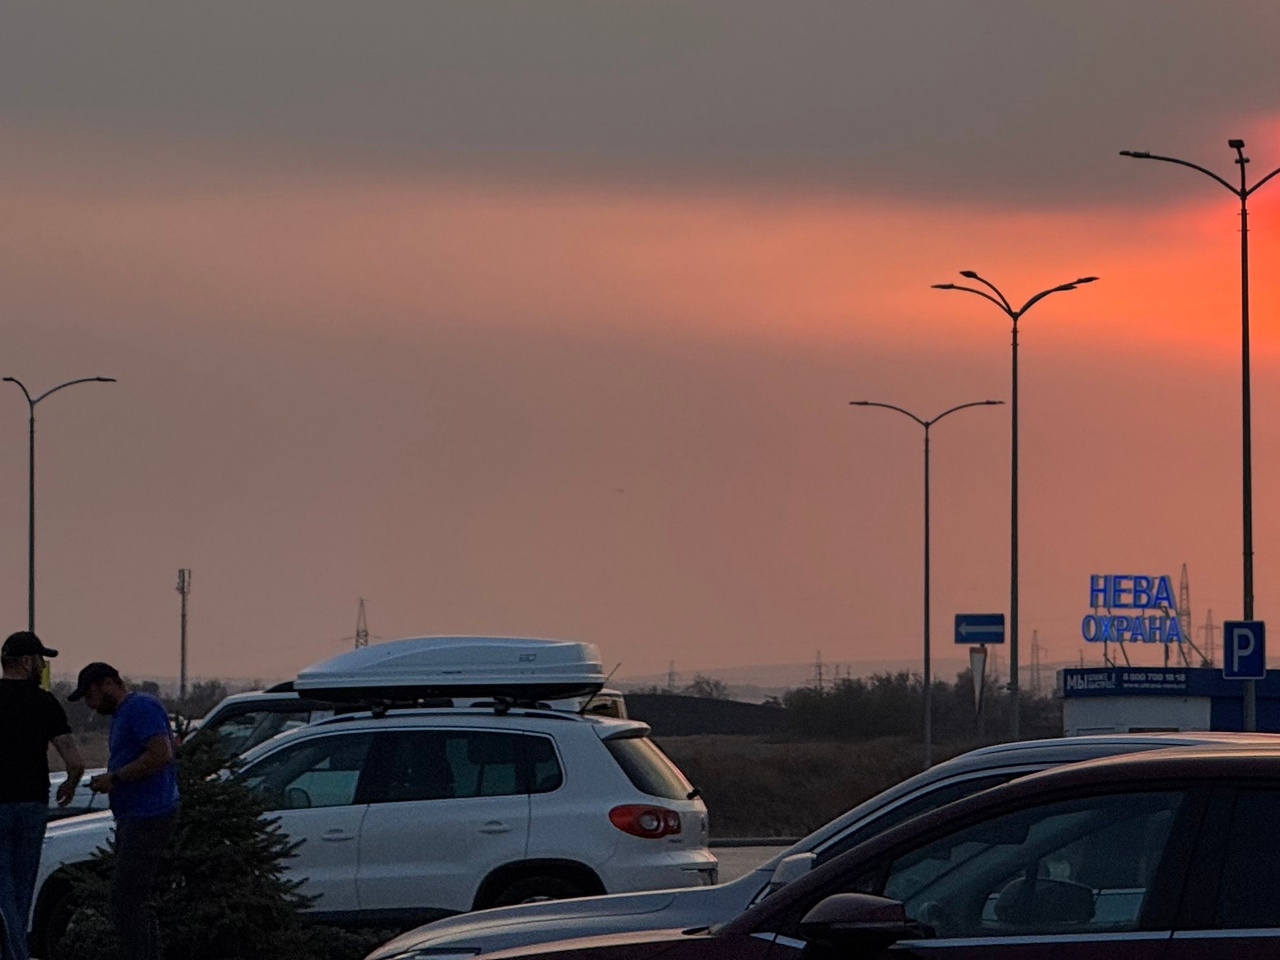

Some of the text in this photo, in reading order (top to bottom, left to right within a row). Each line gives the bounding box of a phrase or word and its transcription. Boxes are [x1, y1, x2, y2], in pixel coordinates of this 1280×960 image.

[1090, 575, 1174, 609] НЕВА
[1082, 615, 1184, 643] ОХРАНА
[1233, 628, 1255, 672] P
